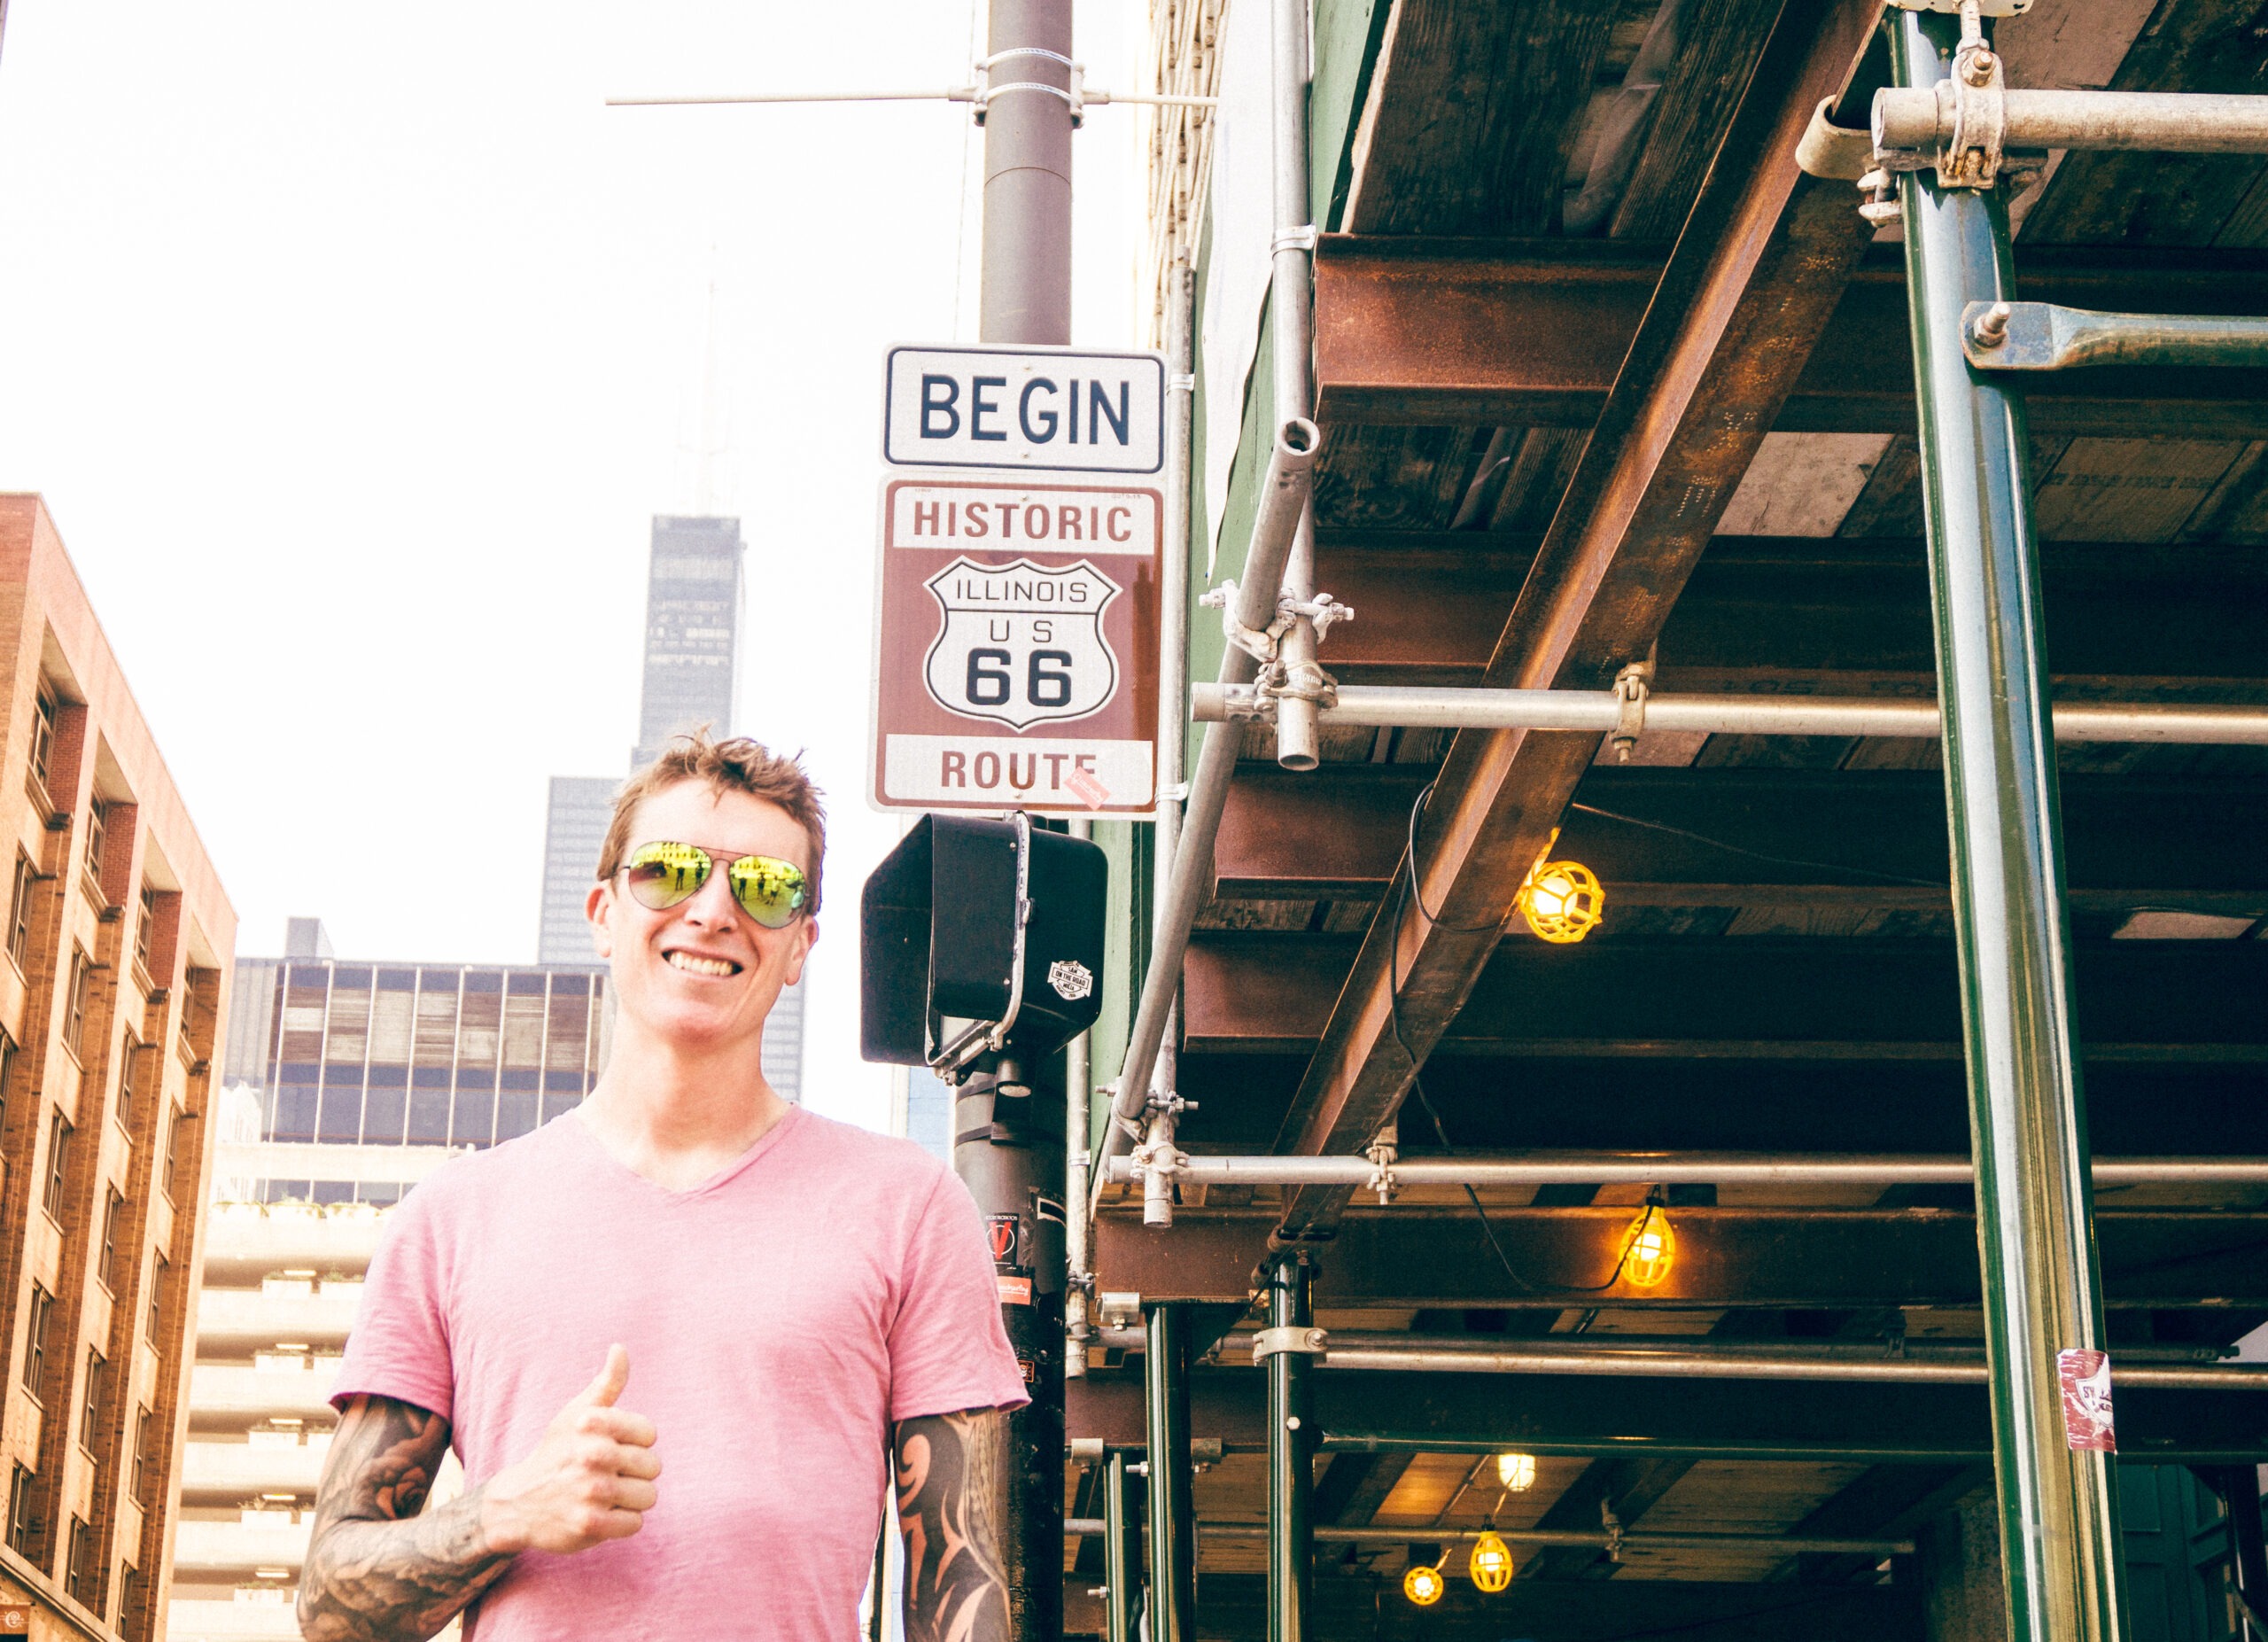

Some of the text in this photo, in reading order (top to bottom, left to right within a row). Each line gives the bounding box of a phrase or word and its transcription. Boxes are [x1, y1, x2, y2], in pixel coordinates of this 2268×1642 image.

[920, 373, 1130, 446] BEGIN
[913, 501, 1131, 542] HISTORIC
[957, 579, 1088, 603] ILLINOIS
[966, 648, 1072, 708] 66
[1073, 977, 1086, 985] ROAD
